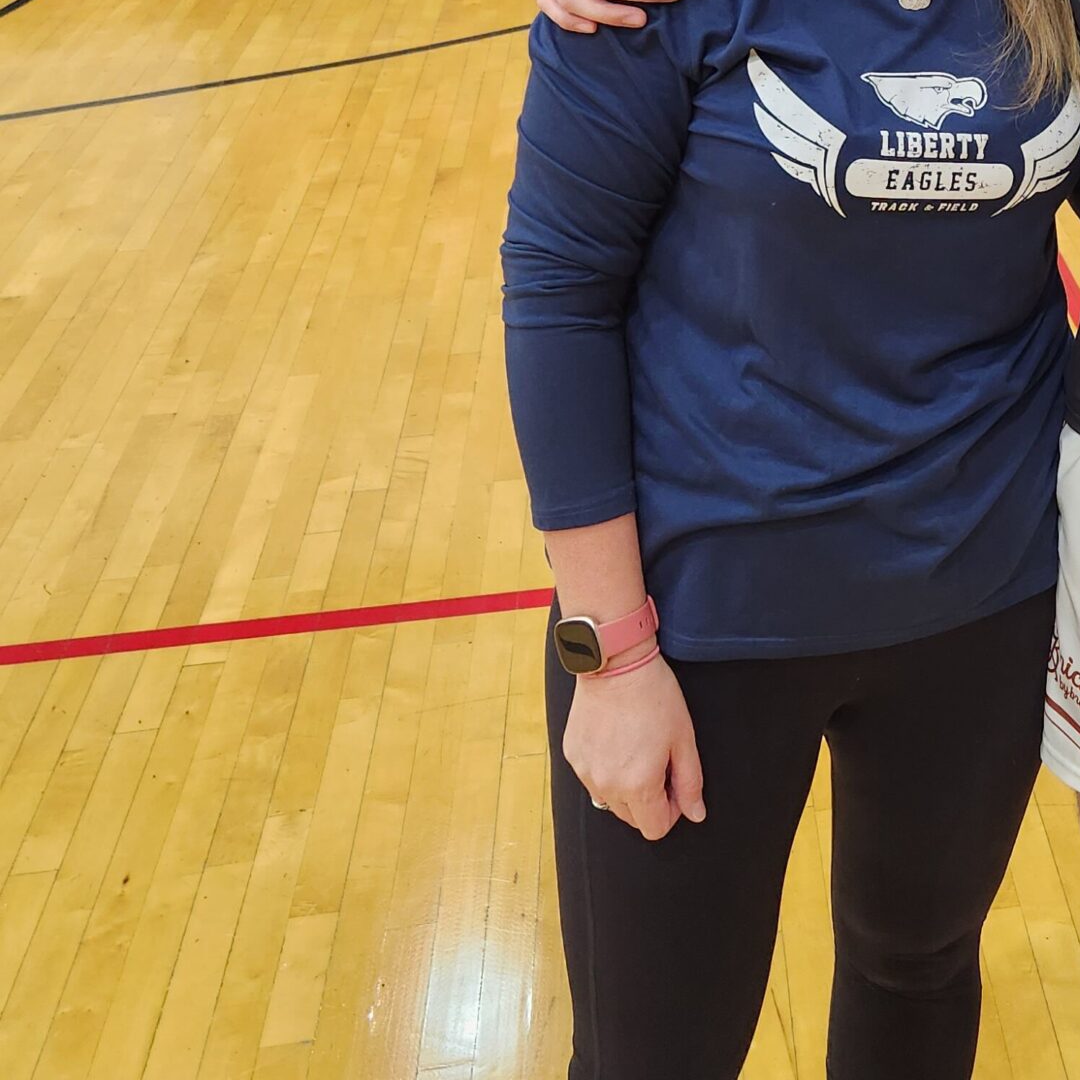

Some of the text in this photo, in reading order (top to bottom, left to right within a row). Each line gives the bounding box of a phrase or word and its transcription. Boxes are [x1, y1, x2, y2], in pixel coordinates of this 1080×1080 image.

[880, 130, 989, 160] LIBERTY
[886, 169, 977, 192] EAGLES
[870, 202, 979, 212] TRACK & FIELD
